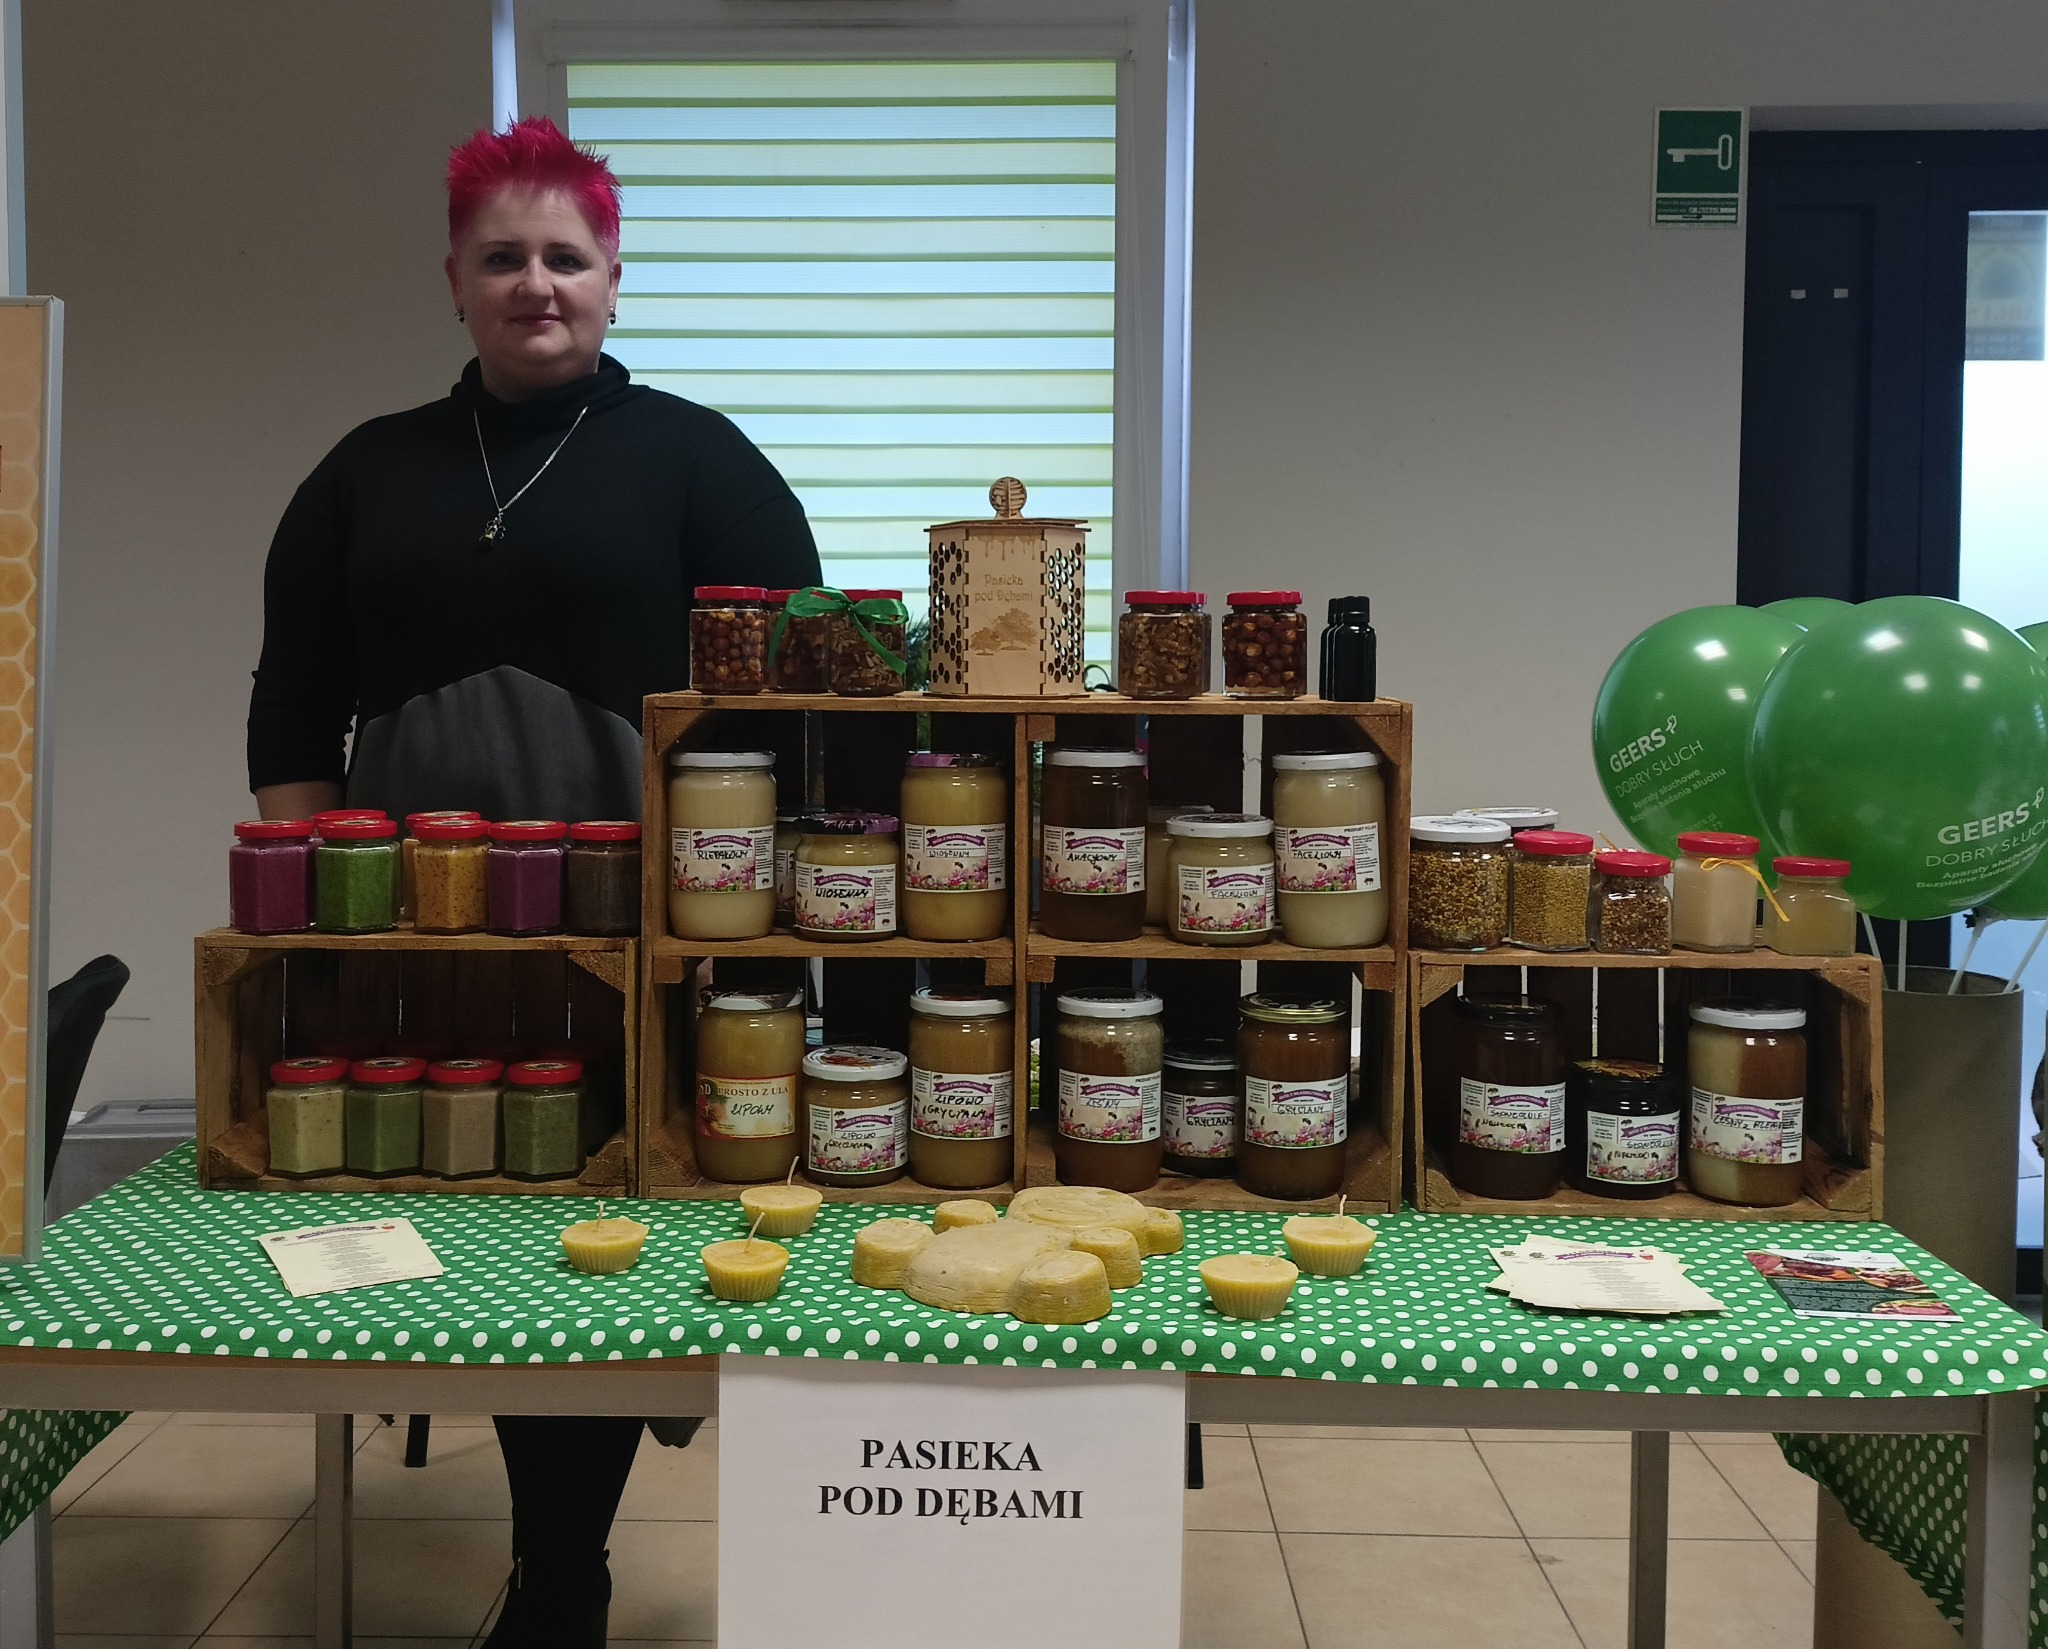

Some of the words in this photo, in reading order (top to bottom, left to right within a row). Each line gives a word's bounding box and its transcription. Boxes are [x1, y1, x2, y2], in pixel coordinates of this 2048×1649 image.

[974, 590, 994, 604] pod
[1609, 726, 1667, 773] GEERS
[1615, 767, 1652, 798] DOBRY
[1651, 740, 1704, 776] SŁUCH
[1692, 767, 1727, 790] słuchu
[1937, 801, 2030, 845] GEERS
[1926, 843, 1998, 867] DOBRY
[1942, 865, 1989, 880] Aparaty
[717, 1087, 760, 1097] PROSTO
[761, 1088, 769, 1096] Z
[771, 1086, 789, 1096] ULA
[936, 1095, 985, 1106] LIPOWO
[860, 1438, 1043, 1472] PASIEKA
[817, 1485, 904, 1516] POD
[915, 1487, 1085, 1526] DĘBAMI
